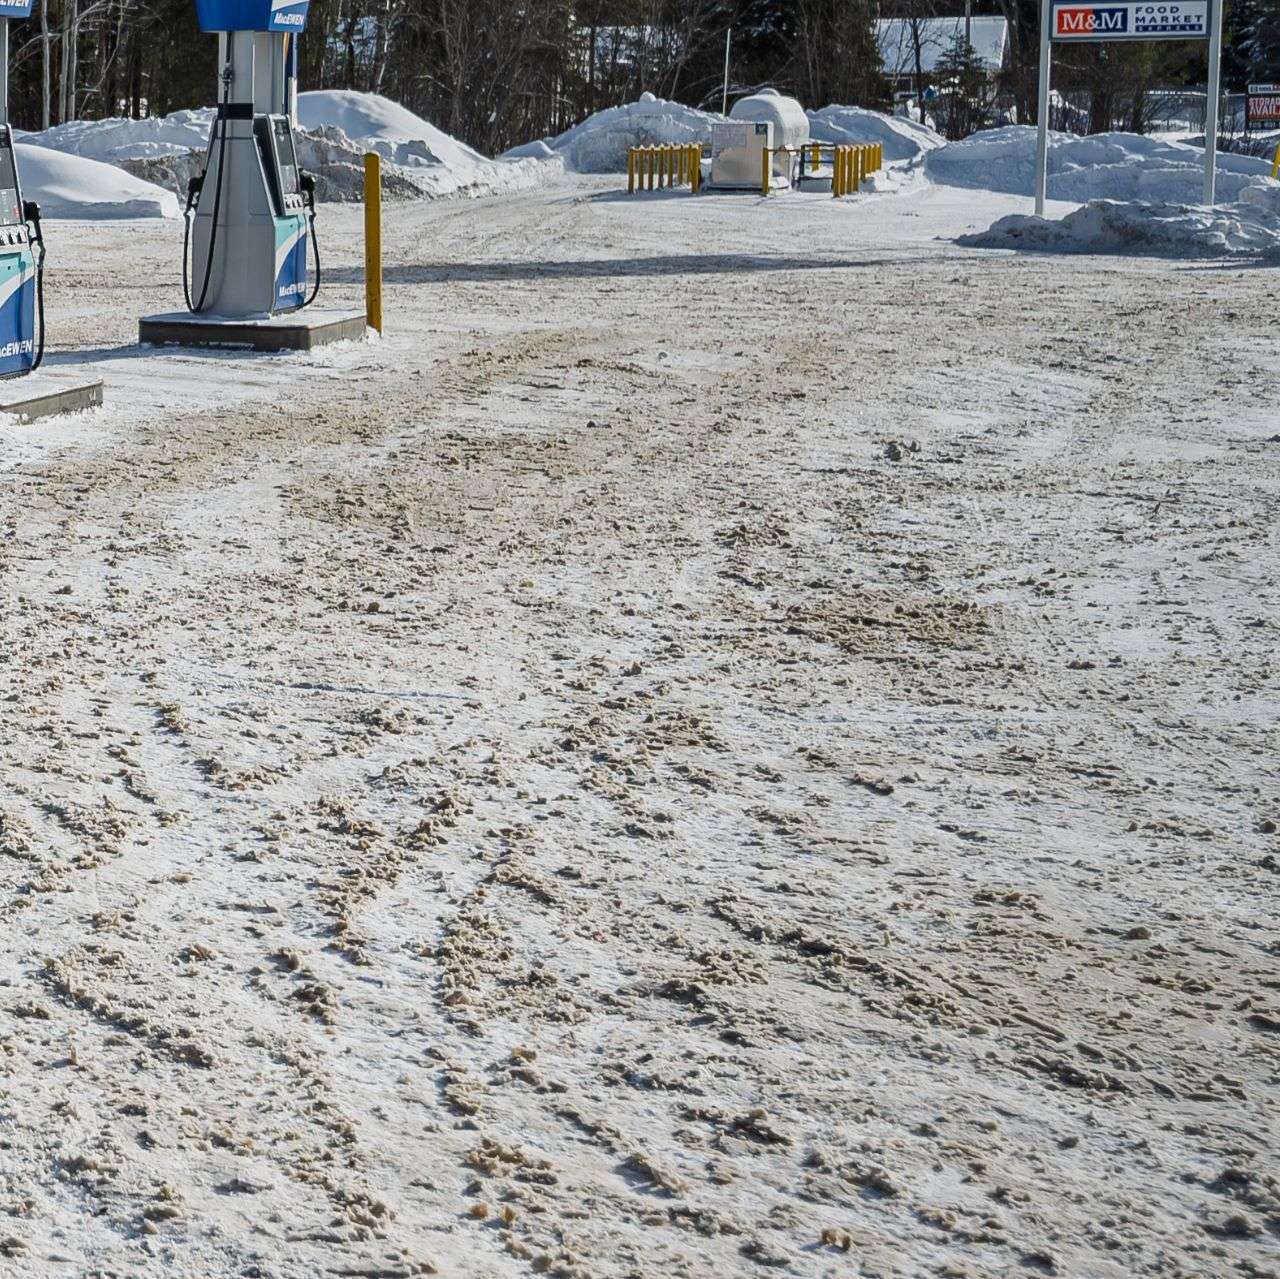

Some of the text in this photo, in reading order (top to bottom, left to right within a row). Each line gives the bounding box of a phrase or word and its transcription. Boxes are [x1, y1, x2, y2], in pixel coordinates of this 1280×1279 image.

[1135, 6, 1180, 15] FOOD
[1062, 11, 1124, 31] M&M
[1135, 14, 1203, 25] MARKET
